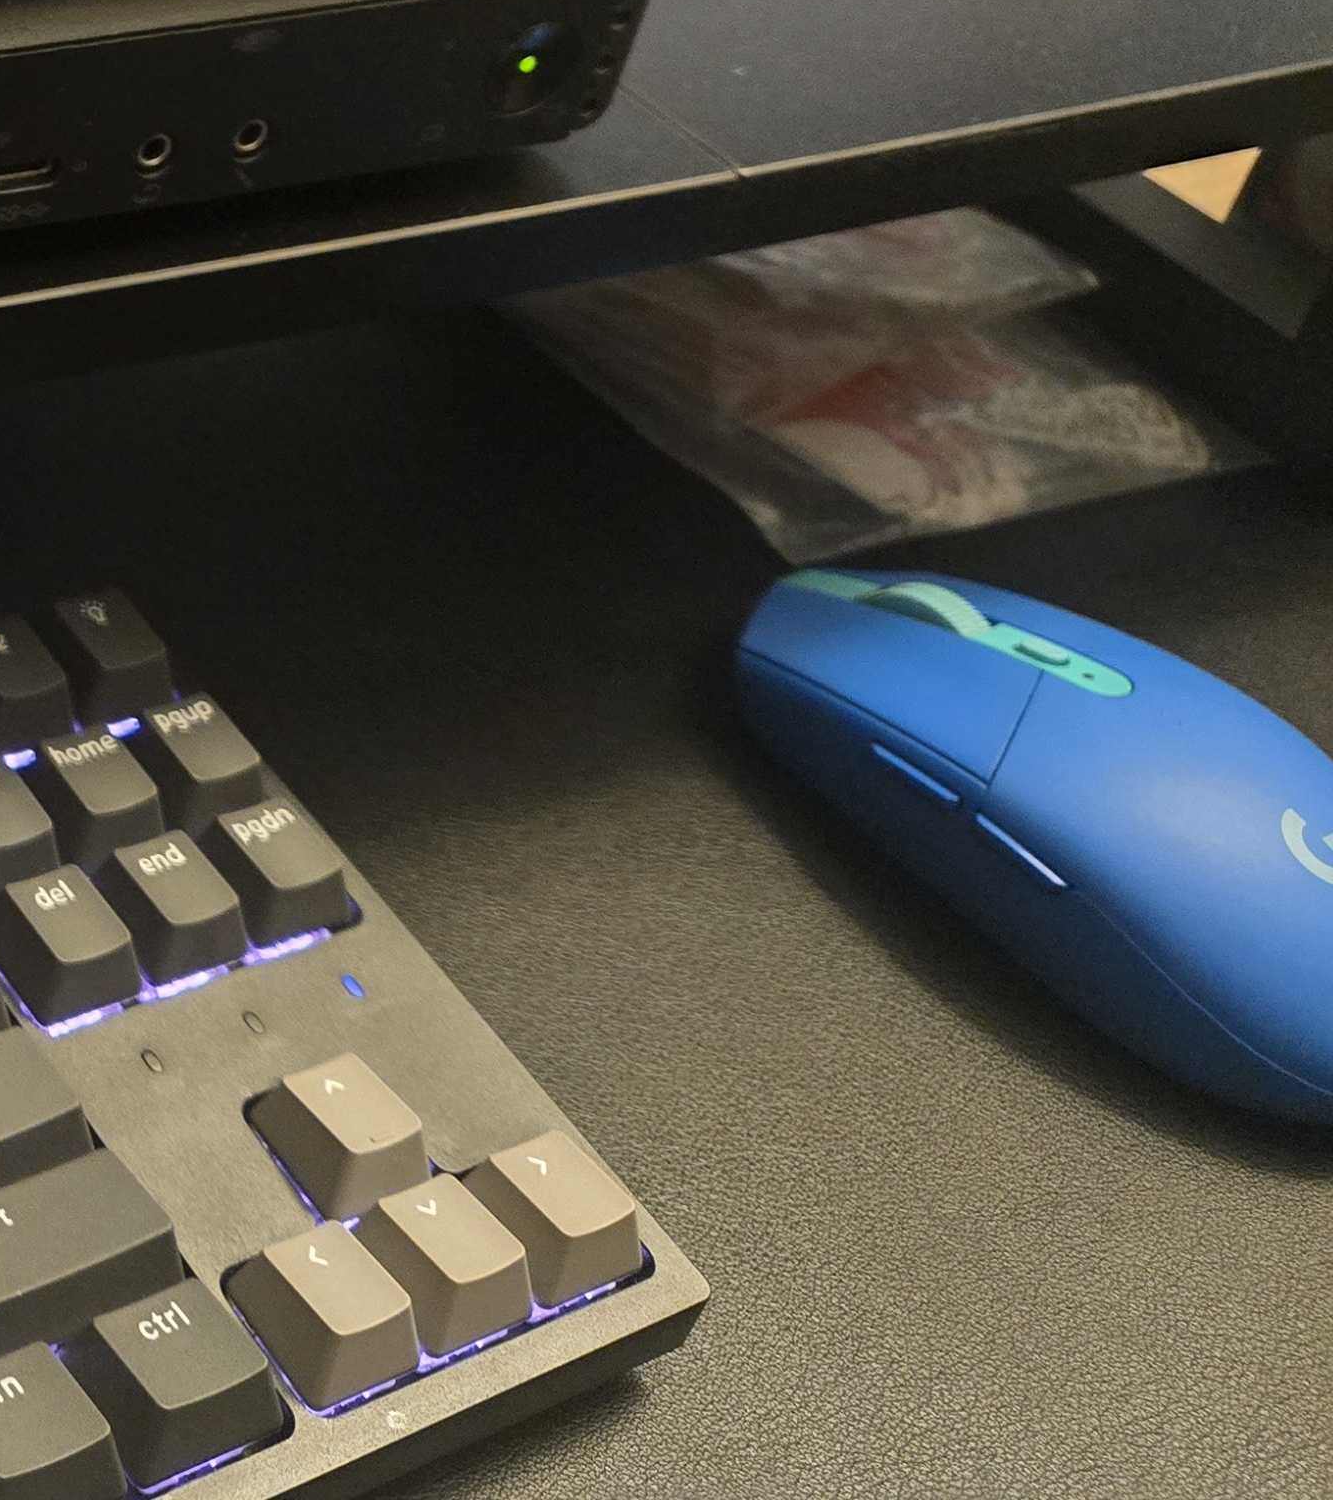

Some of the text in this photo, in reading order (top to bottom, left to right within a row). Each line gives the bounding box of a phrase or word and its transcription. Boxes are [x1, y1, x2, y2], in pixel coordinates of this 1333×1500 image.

[153, 700, 213, 733] pgup
[47, 731, 118, 766] home
[231, 807, 295, 844] pgdn
[139, 842, 187, 875] end
[35, 880, 75, 910] del
[139, 1302, 191, 1340] ctrl
